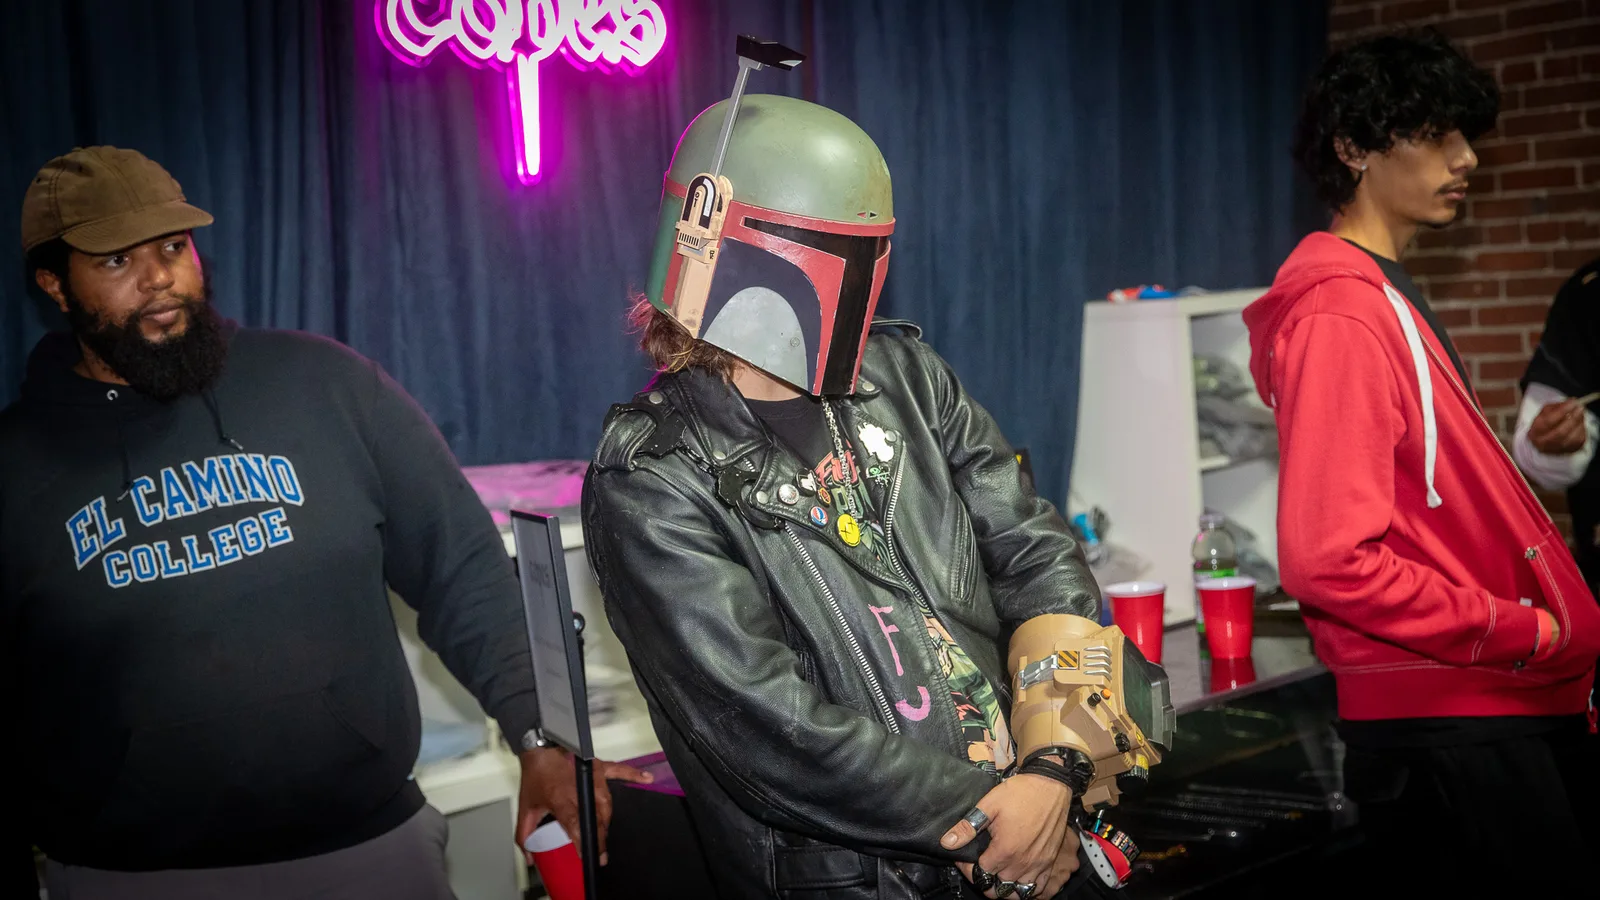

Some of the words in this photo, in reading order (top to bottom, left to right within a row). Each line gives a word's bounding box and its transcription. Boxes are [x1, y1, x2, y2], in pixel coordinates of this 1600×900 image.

[65, 496, 127, 571] EL
[129, 453, 305, 527] CAMINO
[102, 507, 294, 589] COLLEGE
